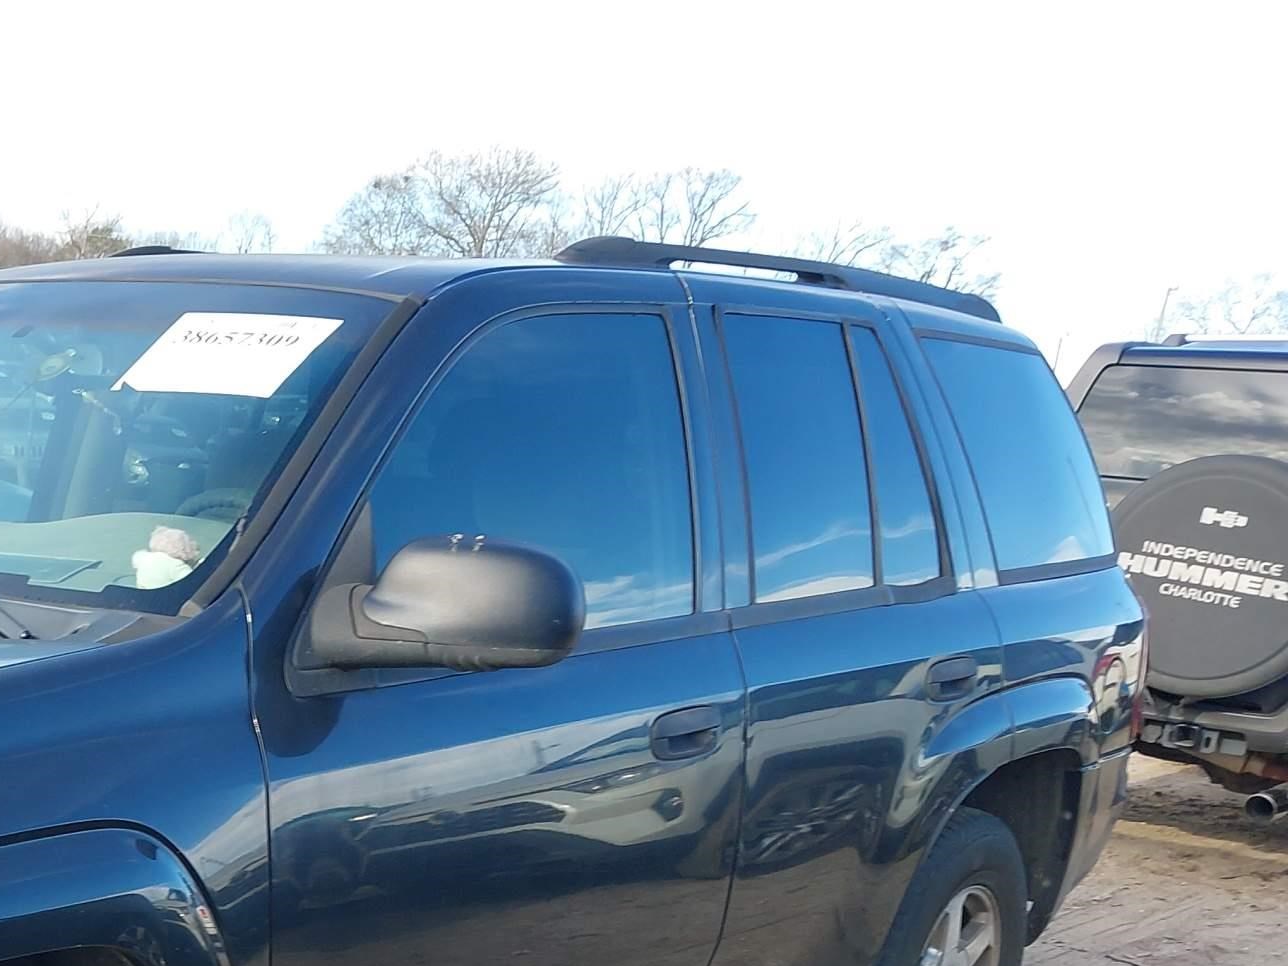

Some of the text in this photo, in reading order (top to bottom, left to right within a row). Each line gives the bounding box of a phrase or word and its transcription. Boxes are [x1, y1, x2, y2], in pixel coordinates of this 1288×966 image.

[174, 329, 301, 347] 38657309
[1141, 540, 1285, 577] INDEPENDENCE
[1116, 551, 1288, 602] HUMMER
[1158, 583, 1243, 608] CHARLOTTE
